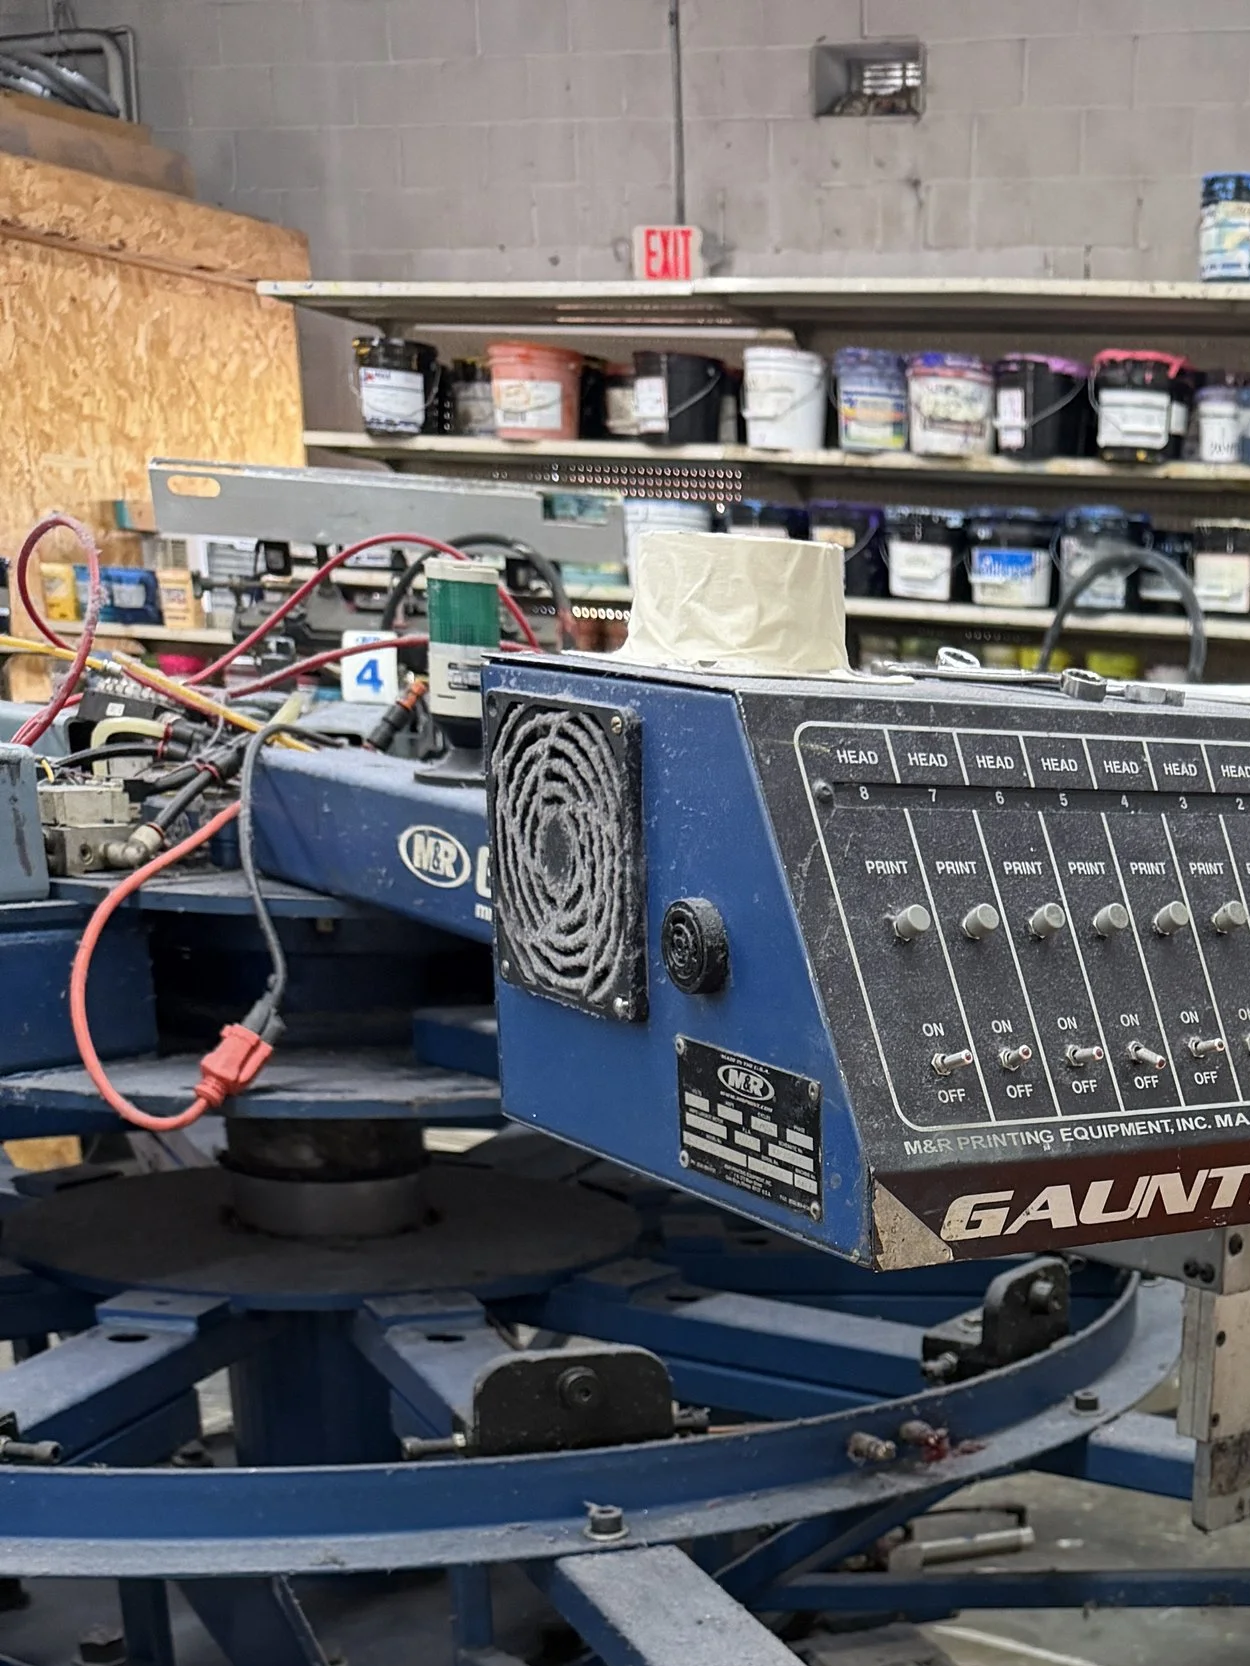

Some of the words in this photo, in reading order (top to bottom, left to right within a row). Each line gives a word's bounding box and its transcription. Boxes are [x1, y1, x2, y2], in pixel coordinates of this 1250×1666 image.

[645, 229, 692, 279] EXIT
[356, 659, 383, 693] 4
[836, 750, 878, 765] HEAD
[908, 753, 948, 767] HEAD
[976, 755, 1014, 770] HEAD
[1041, 758, 1078, 772] HEAD
[1104, 760, 1139, 775] HEAD
[1164, 763, 1197, 777] HEAD
[860, 786, 869, 800] 8
[929, 789, 937, 802] 7
[996, 792, 1004, 805] 6
[1060, 793, 1068, 807] 5
[1120, 795, 1128, 808] 4
[1180, 797, 1188, 809] 3
[1237, 798, 1244, 810] 2
[413, 833, 457, 878] M&R
[865, 860, 908, 875] PRINT
[936, 860, 977, 875] PRINT
[1004, 861, 1043, 875] PRINT
[1068, 861, 1105, 875] PRINT
[1130, 862, 1166, 875] PRINT
[1189, 862, 1224, 875] PRINT
[922, 1023, 944, 1037] ON
[992, 1019, 1012, 1033] ON
[1058, 1017, 1077, 1030] ON
[1120, 1014, 1139, 1027] ON
[1180, 1010, 1199, 1024] ON
[728, 1069, 764, 1096] M&R
[938, 1089, 966, 1103] OFF
[1007, 1084, 1033, 1099] OFF
[1072, 1080, 1097, 1094] OFF
[1135, 1075, 1159, 1089] OFF
[1194, 1070, 1218, 1085] OFF
[903, 1138, 953, 1155] M&R
[956, 1128, 1055, 1152] PRINTING
[1176, 1114, 1212, 1133] INC.
